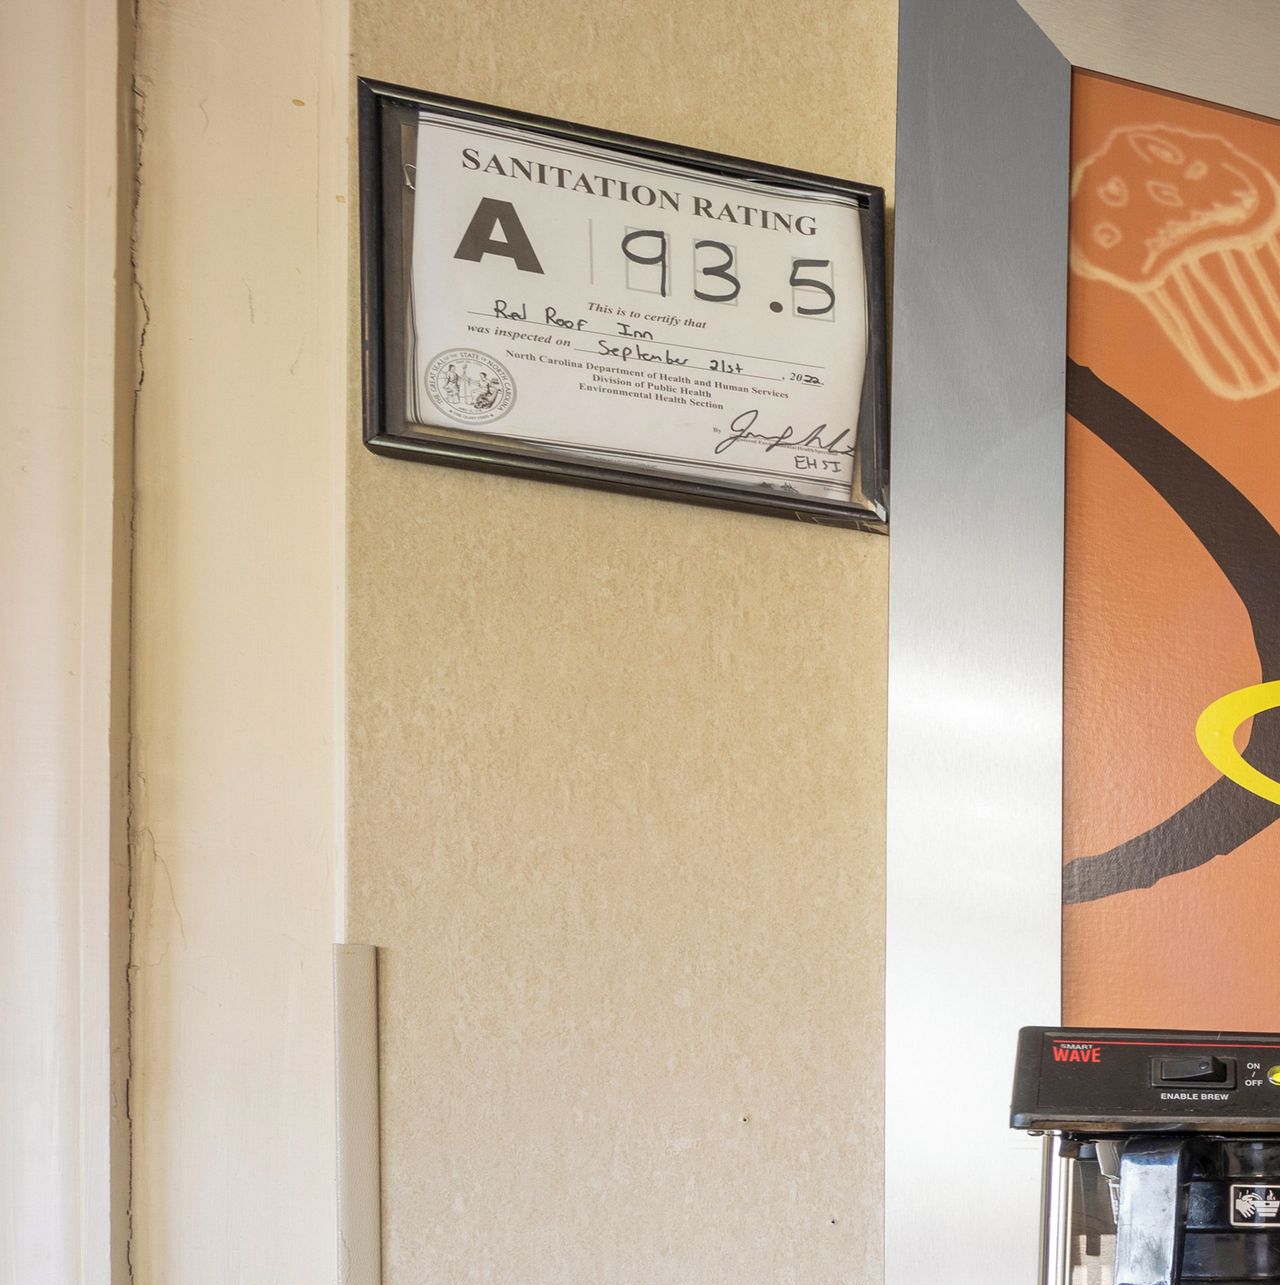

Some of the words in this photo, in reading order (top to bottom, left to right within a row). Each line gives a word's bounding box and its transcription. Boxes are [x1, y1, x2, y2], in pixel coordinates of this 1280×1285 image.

[462, 148, 681, 212] SANITATION
[692, 196, 817, 236] RATING
[453, 197, 545, 275] A
[494, 300, 527, 320] Red
[545, 307, 588, 331] Roof
[617, 322, 653, 339] Inn
[588, 302, 616, 314] This
[617, 305, 627, 316] is
[629, 309, 641, 320] to
[643, 311, 682, 326] certify
[684, 317, 707, 329] that
[466, 324, 490, 335] was
[494, 327, 552, 344] inspected
[555, 338, 572, 347] on
[598, 340, 688, 365] September
[709, 359, 743, 374] 21st
[460, 351, 479, 359] STATE
[487, 360, 509, 380] NORTH
[506, 350, 536, 362] North
[539, 355, 583, 368] Carolina
[586, 362, 644, 378] Department
[647, 372, 657, 380] of
[659, 372, 691, 385] Health
[693, 378, 711, 387] and
[714, 381, 749, 393] Human
[751, 386, 789, 399] Services
[579, 383, 652, 399] Environmental
[655, 393, 687, 404] Health
[689, 399, 724, 410] Section
[593, 374, 632, 387] Division
[635, 379, 645, 388] of
[647, 382, 677, 393] Public
[680, 387, 712, 398] Health
[1053, 1046, 1102, 1063] WAVE
[1160, 1093, 1199, 1101] ENABLE
[1201, 1093, 1230, 1101] BREW
